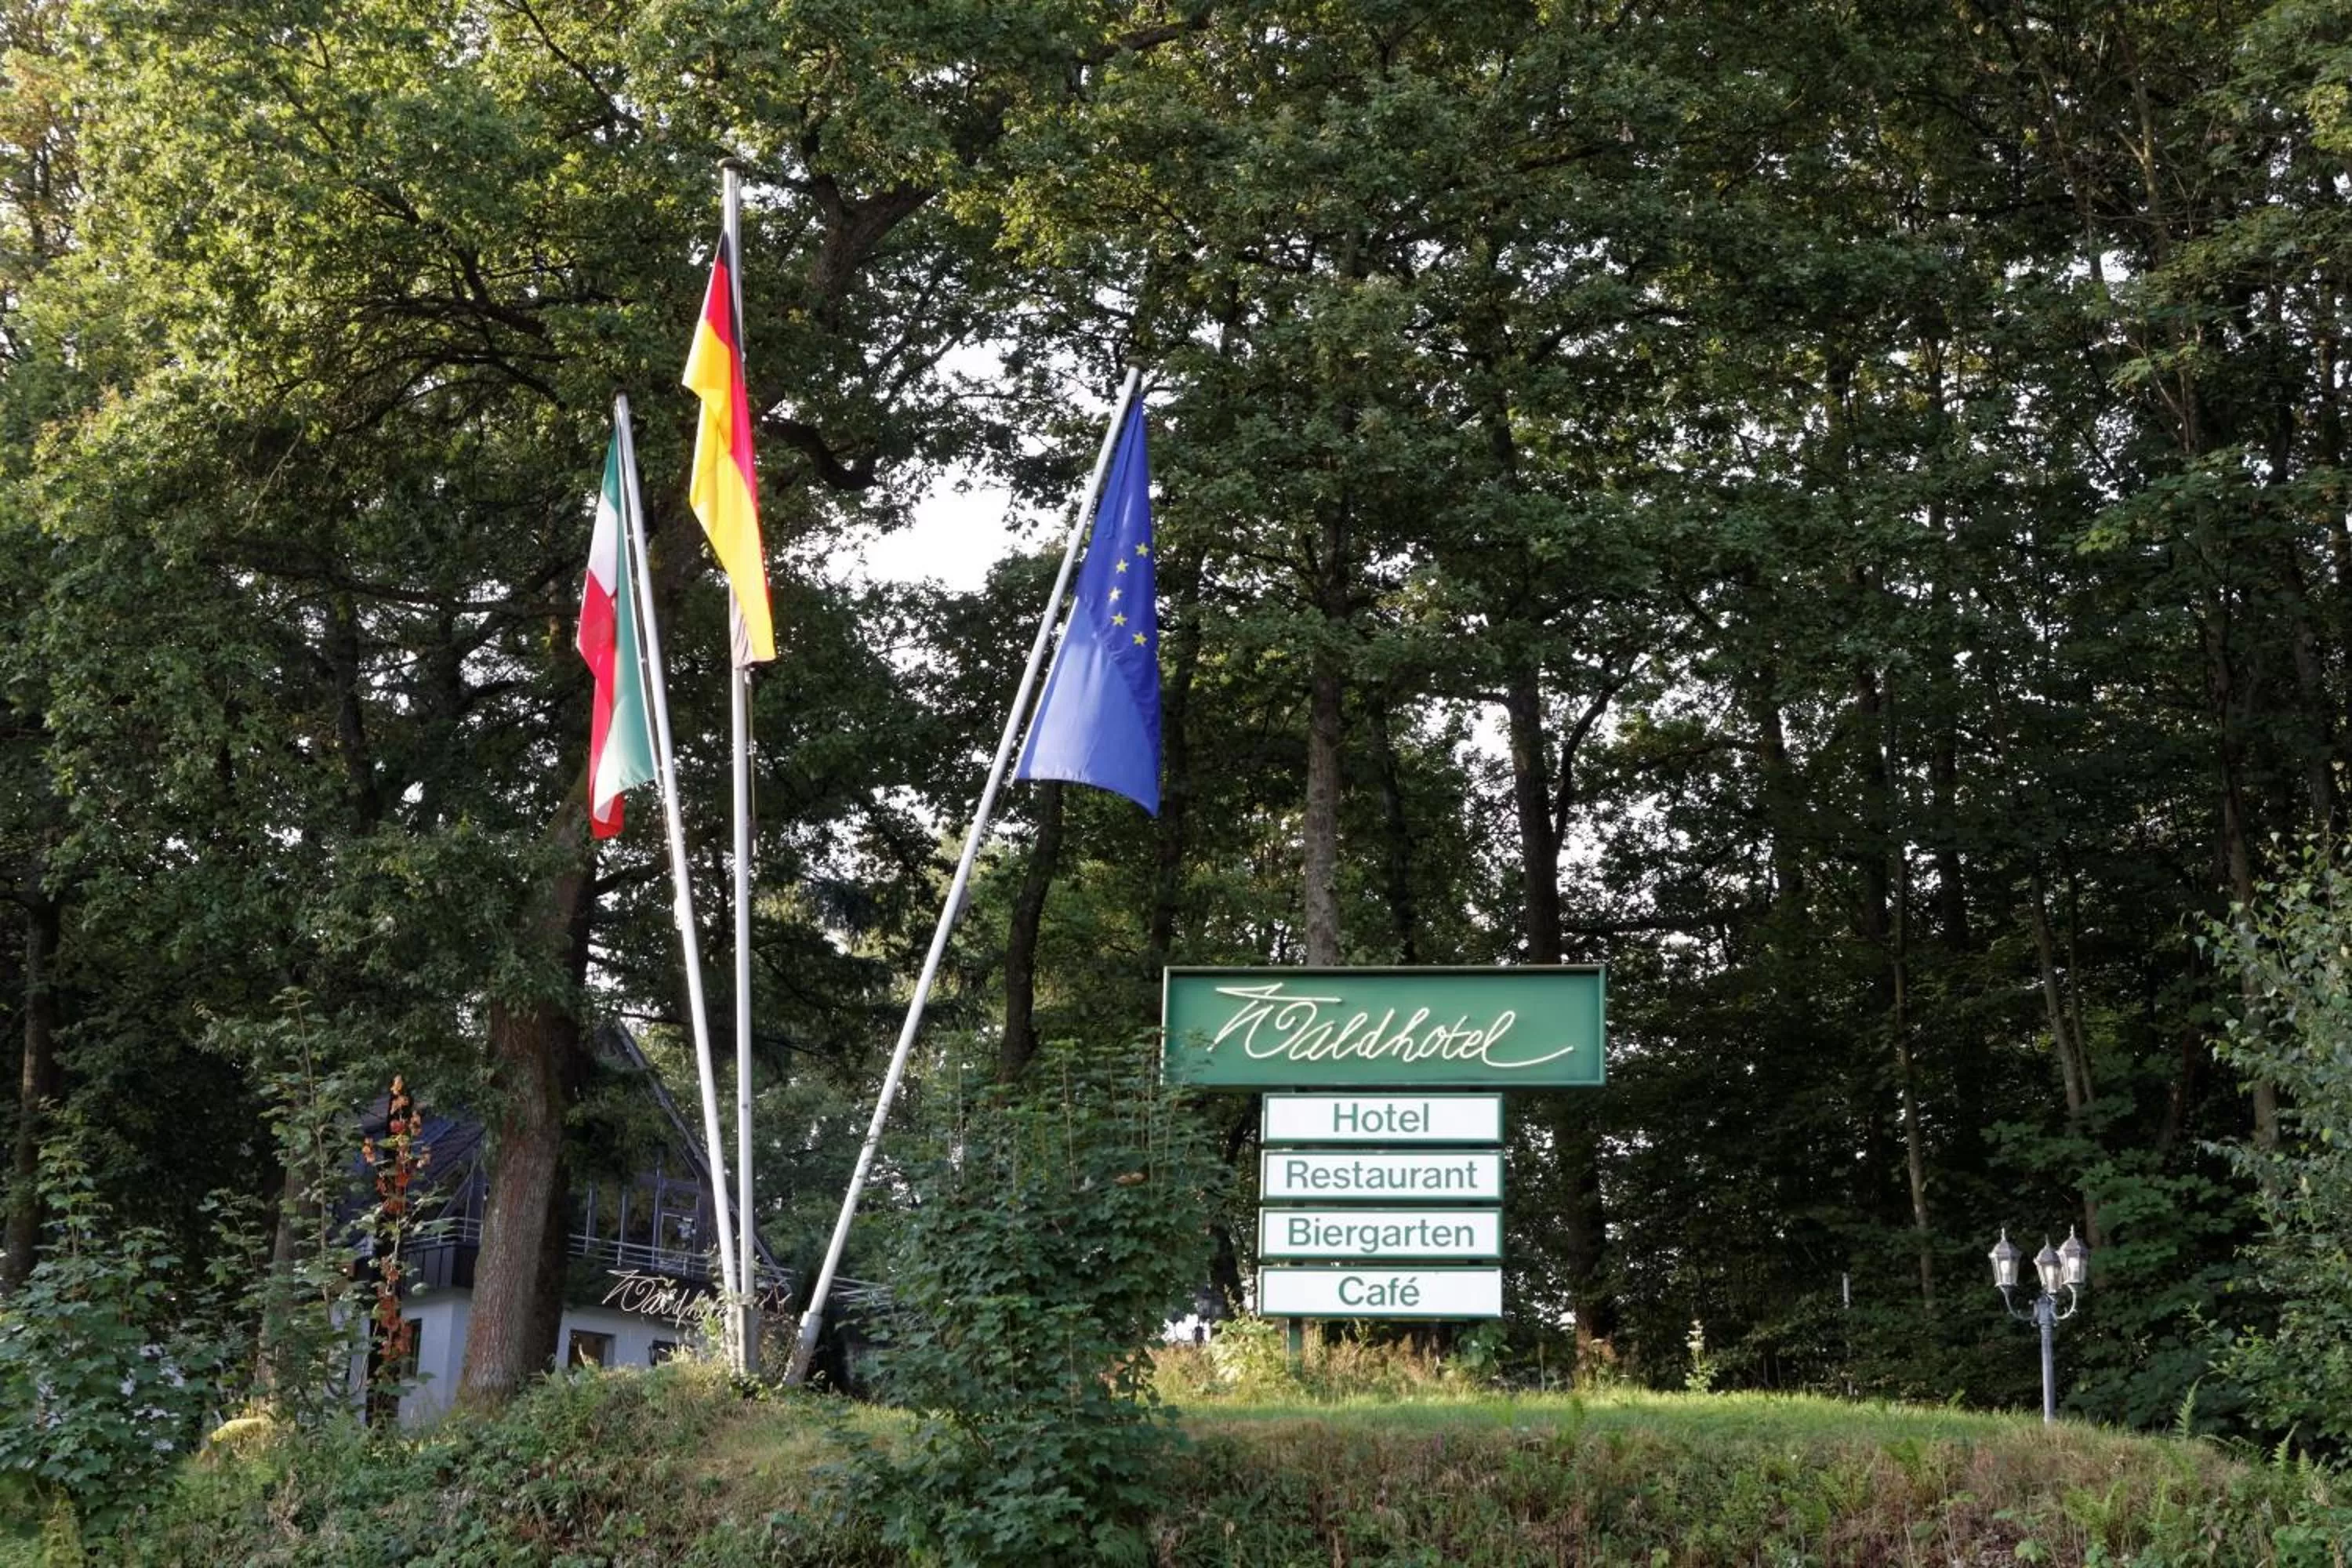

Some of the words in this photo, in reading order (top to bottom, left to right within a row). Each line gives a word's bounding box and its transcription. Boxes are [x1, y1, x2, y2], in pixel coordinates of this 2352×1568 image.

[1207, 982, 1575, 1068] Waldhotel
[1333, 1102, 1429, 1133] Hotel
[1286, 1160, 1478, 1189] Restaurant
[1287, 1217, 1475, 1254] Biergarten
[1338, 1276, 1421, 1307] Café
